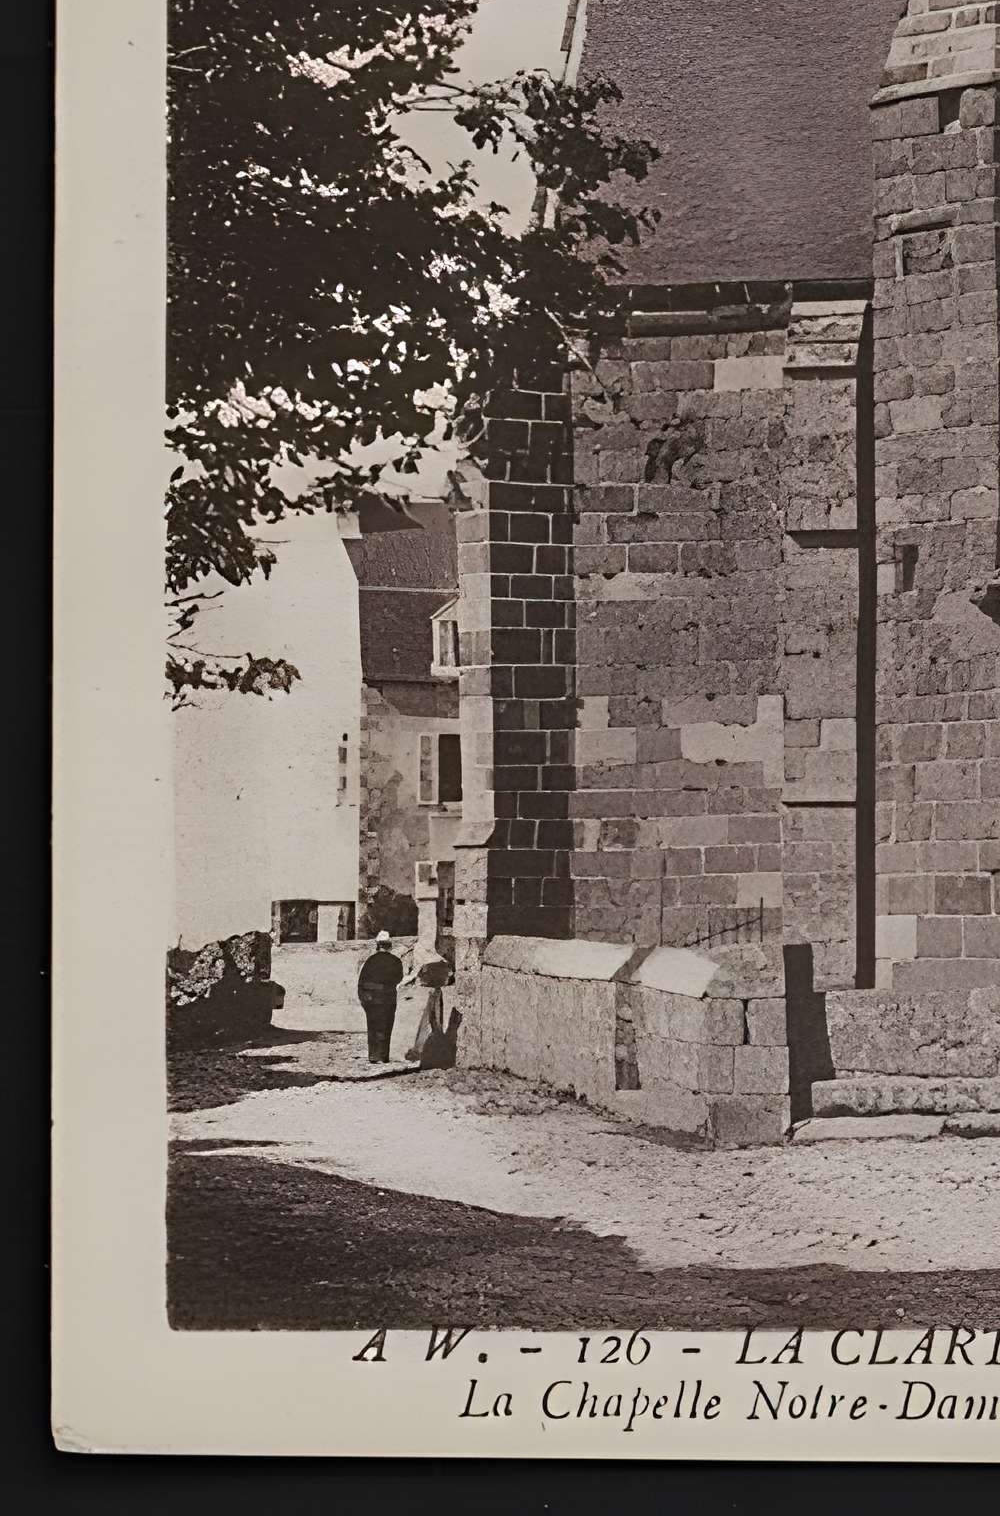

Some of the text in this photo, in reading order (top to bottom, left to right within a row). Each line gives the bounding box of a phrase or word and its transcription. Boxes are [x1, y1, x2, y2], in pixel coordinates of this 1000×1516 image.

[577, 1327, 651, 1366] 126
[735, 1327, 804, 1365] LA
[458, 1378, 514, 1418] La
[541, 1379, 721, 1433] Chapelle
